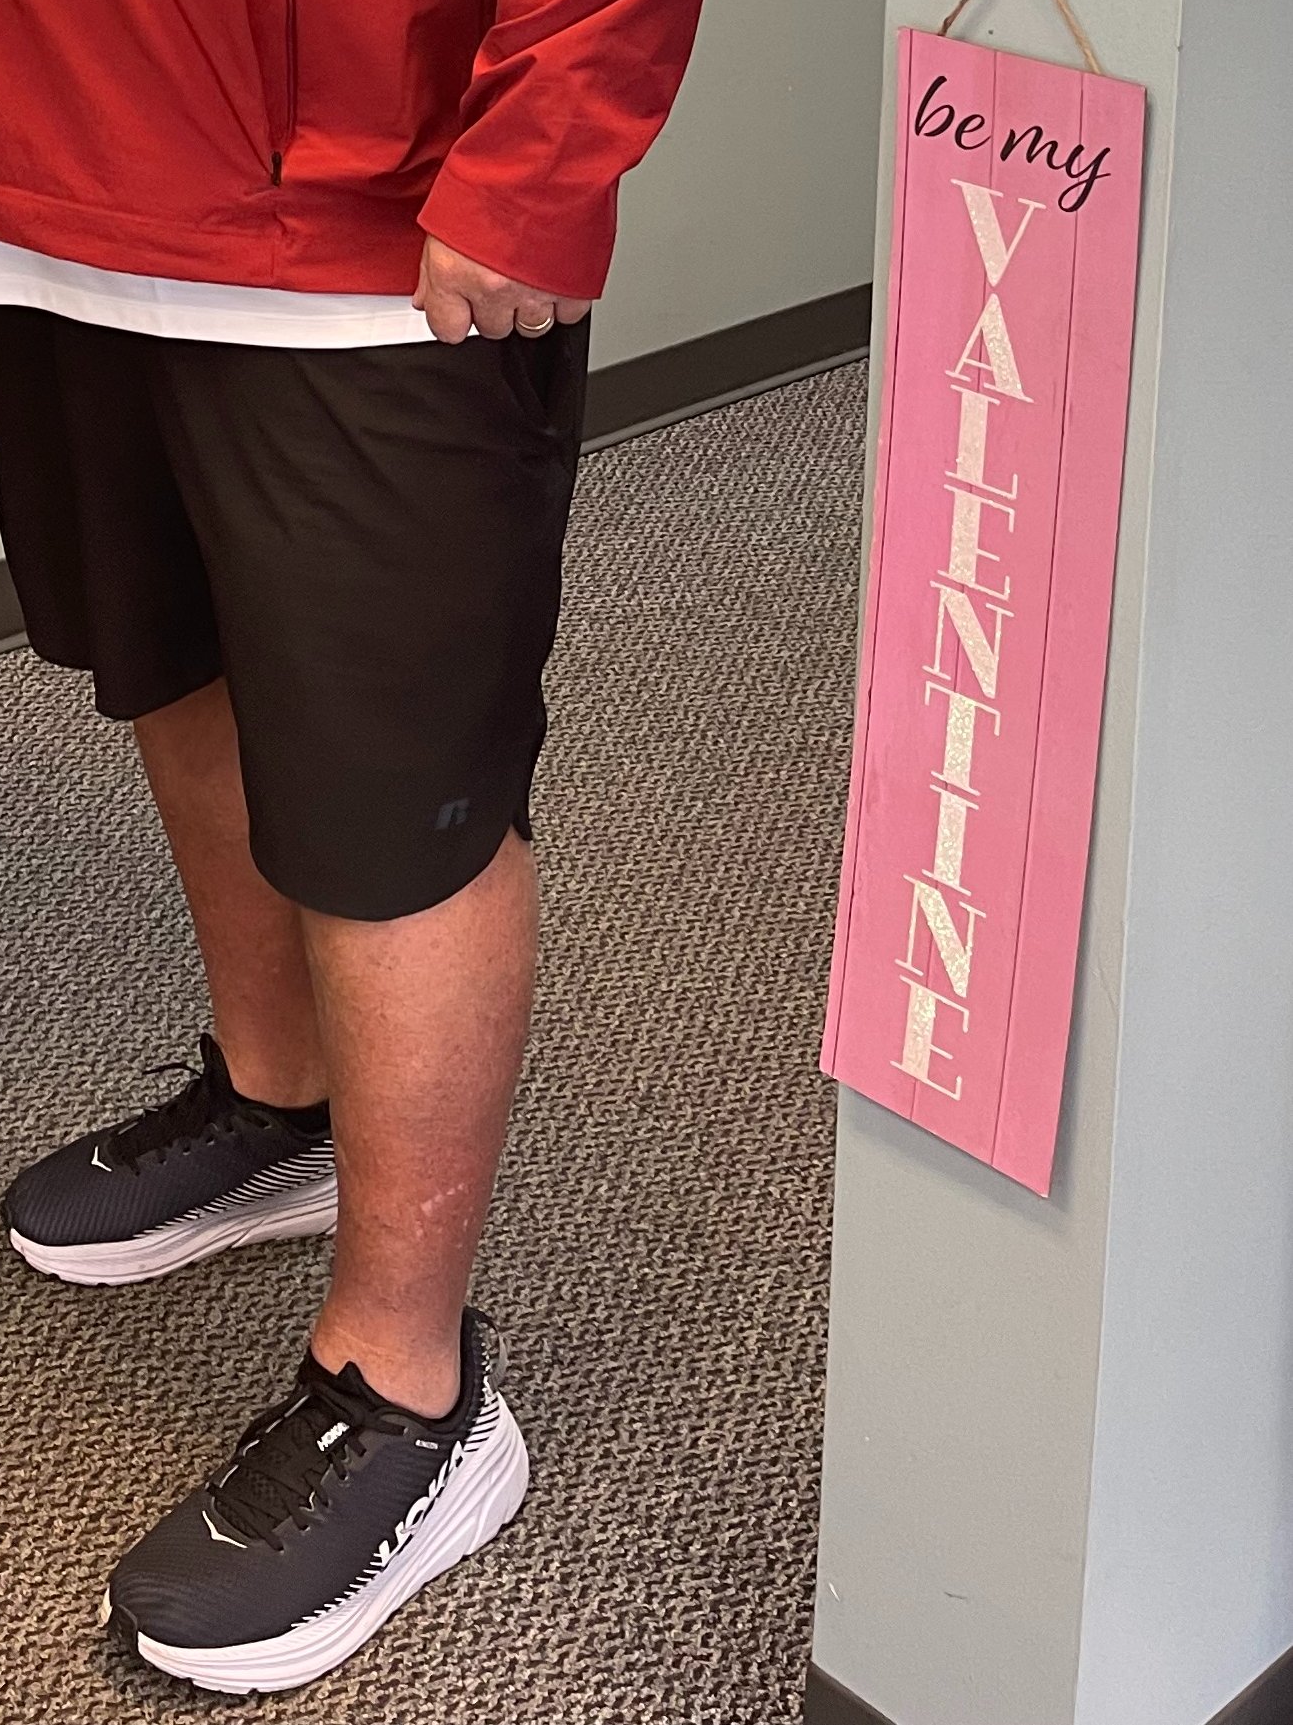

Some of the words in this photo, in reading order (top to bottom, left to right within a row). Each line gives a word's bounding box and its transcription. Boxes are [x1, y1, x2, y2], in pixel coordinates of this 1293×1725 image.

[914, 75, 993, 151] be
[999, 125, 1112, 213] my
[890, 178, 1048, 1102] VALENTINE
[316, 1421, 350, 1452] HOKA
